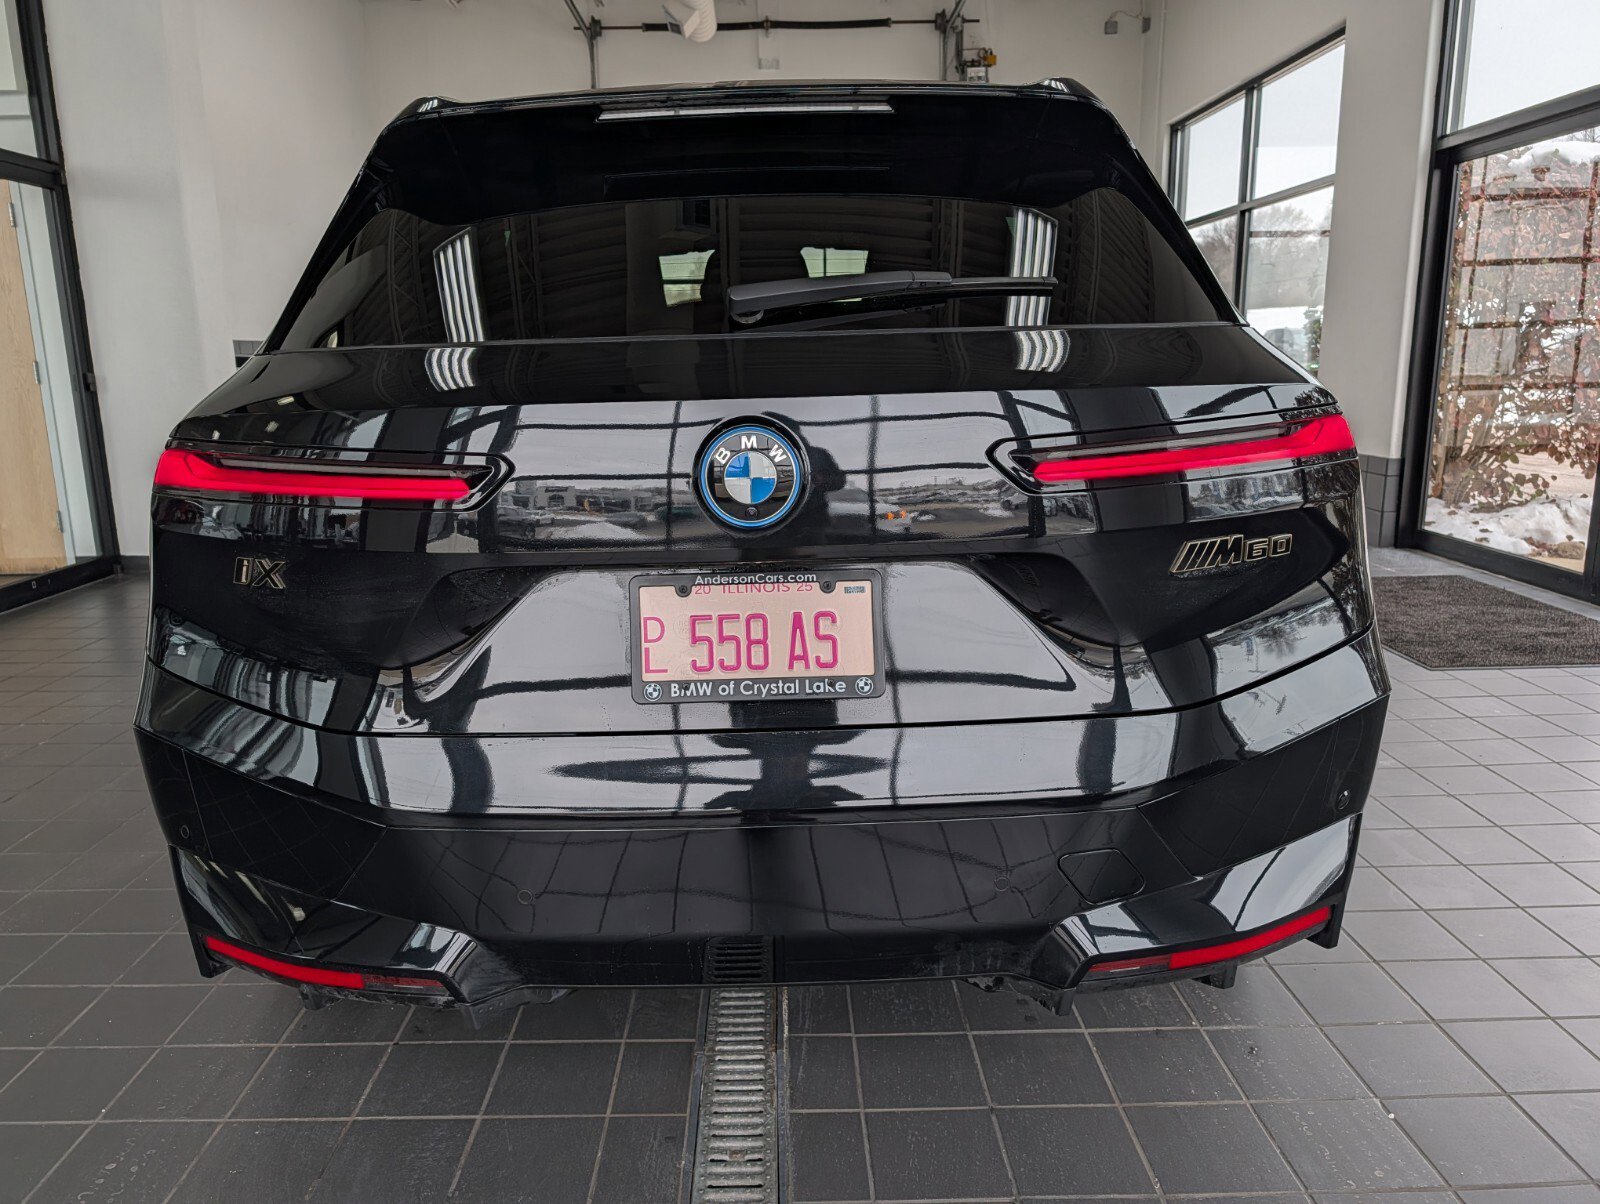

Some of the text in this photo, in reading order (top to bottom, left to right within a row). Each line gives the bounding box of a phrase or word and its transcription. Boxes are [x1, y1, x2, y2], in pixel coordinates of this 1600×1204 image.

[715, 435, 787, 464] BMW
[695, 573, 817, 585] AndersonCars.com
[695, 582, 813, 595] 20 ILLINOIS 25
[690, 610, 839, 673] 558 AS
[719, 681, 735, 695] of
[740, 679, 800, 698] Crystal
[805, 678, 847, 693] Lake
